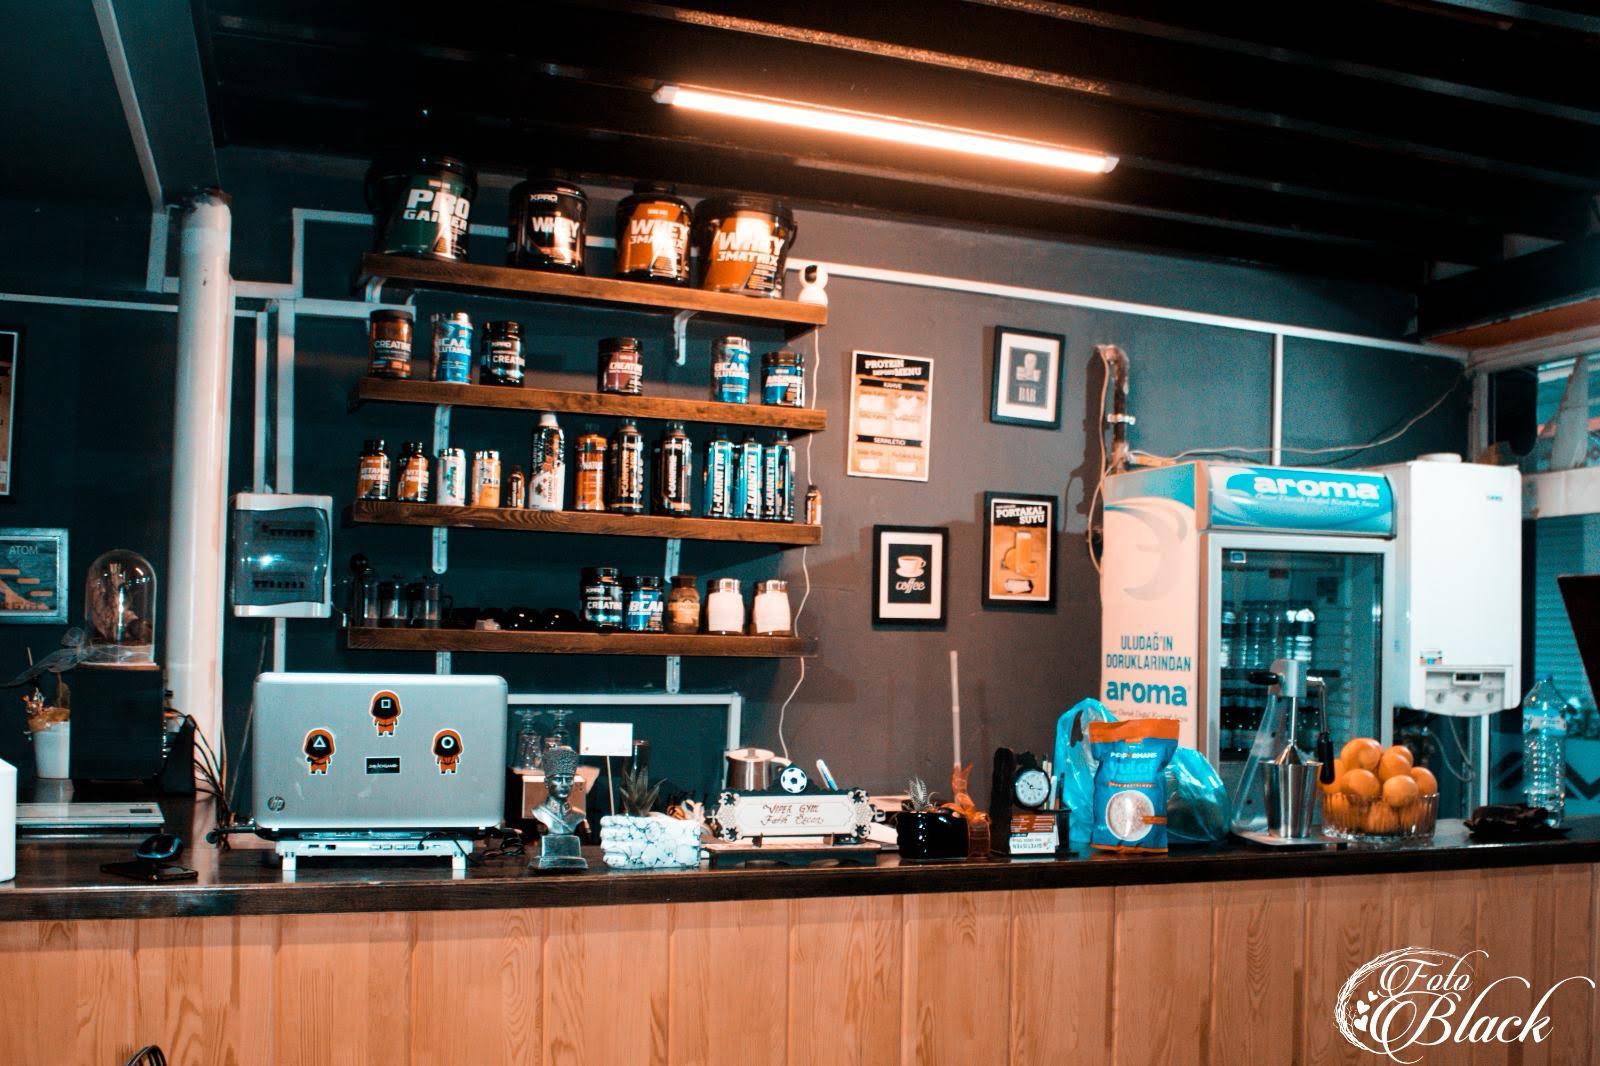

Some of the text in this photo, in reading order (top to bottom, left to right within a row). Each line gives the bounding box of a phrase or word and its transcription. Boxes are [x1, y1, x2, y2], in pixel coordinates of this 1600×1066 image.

[404, 188, 470, 219] PRO
[402, 209, 468, 230] GAINER
[531, 215, 580, 239] WHEY
[630, 218, 690, 245] WHEY
[717, 231, 786, 257] WHEY
[864, 358, 905, 370] PROTEIN
[894, 366, 922, 377] MENU
[1018, 386, 1037, 403] BAR
[1253, 476, 1380, 500] aroma
[995, 505, 1046, 519] PORTAKAL
[1019, 514, 1045, 525] SUYU
[8, 545, 39, 555] ATOM
[895, 577, 926, 594] coffee
[1105, 653, 1191, 672] DORUKLARINDAN
[1106, 681, 1188, 707] aroma
